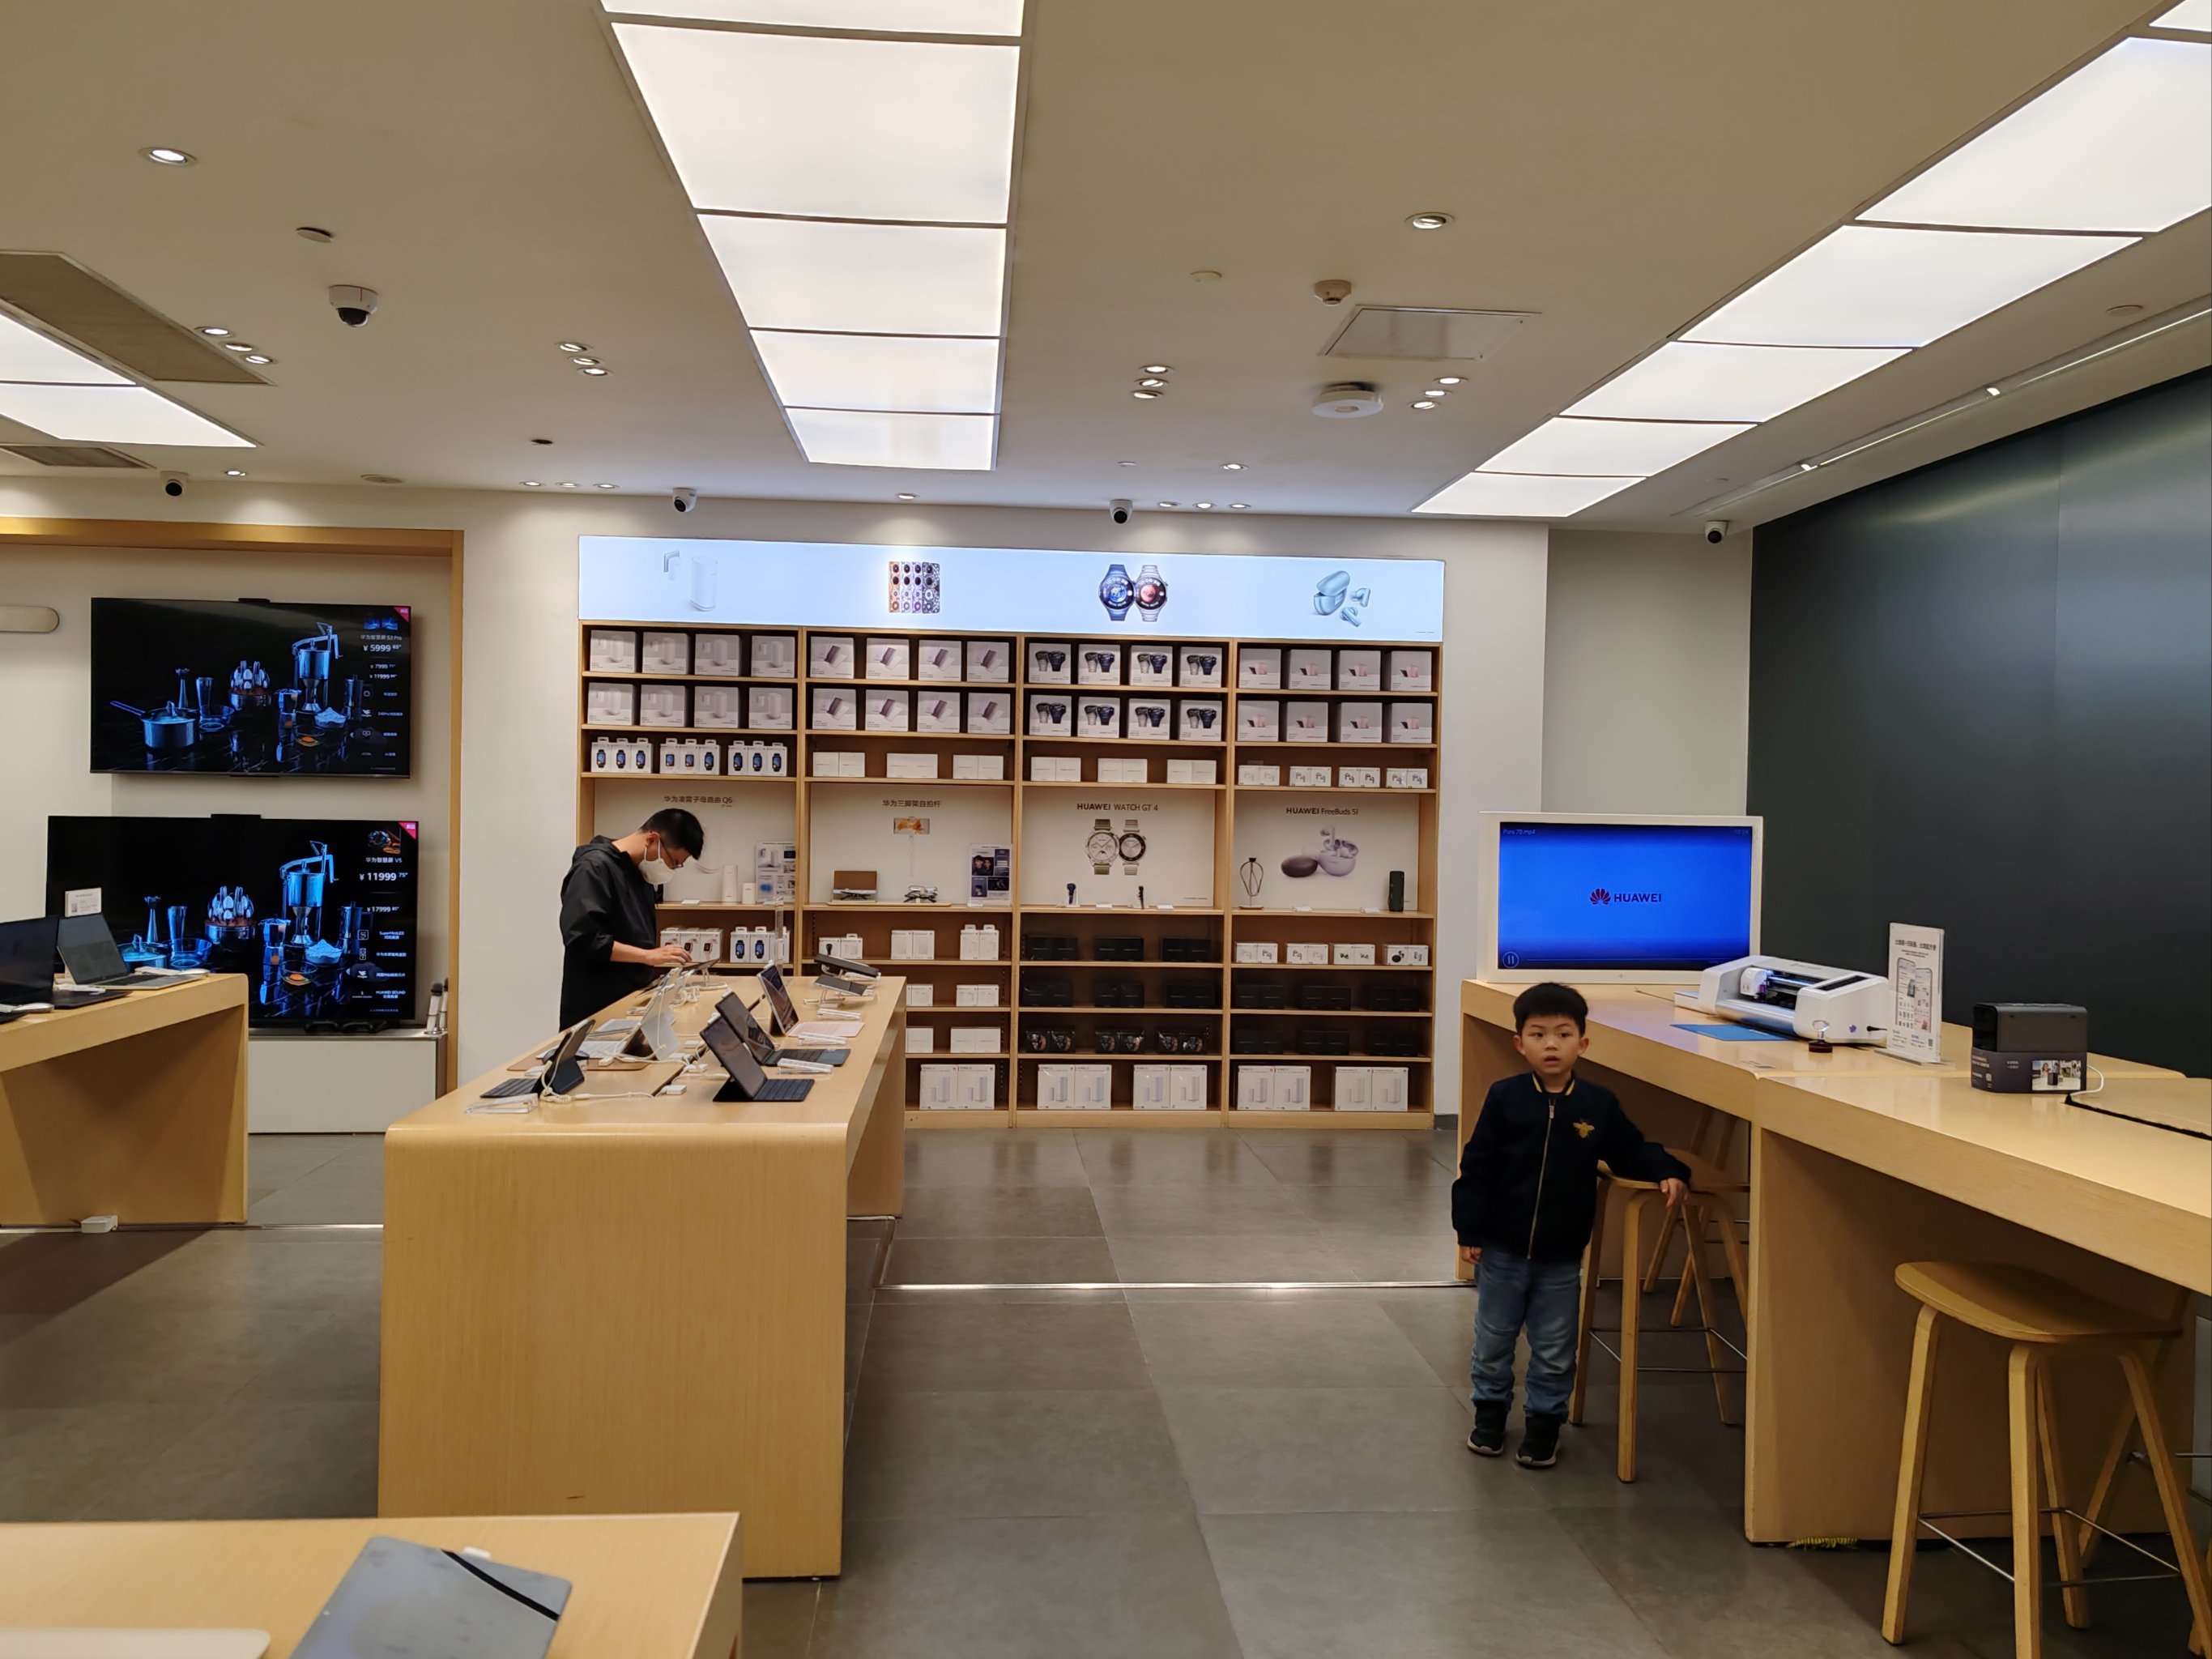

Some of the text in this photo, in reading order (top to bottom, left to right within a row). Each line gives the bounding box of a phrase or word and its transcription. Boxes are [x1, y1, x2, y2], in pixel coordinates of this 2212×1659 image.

[370, 644, 391, 652] 5999
[882, 799, 941, 808] 华为三脚架自拍杆
[1076, 803, 1111, 811] HUAWEI
[1113, 803, 1140, 811] WATCH
[1285, 807, 1319, 815] HUAWEI
[1321, 808, 1351, 816] FreeBuds
[367, 872, 397, 881] 11999
[1614, 893, 1661, 903] HUAWEI
